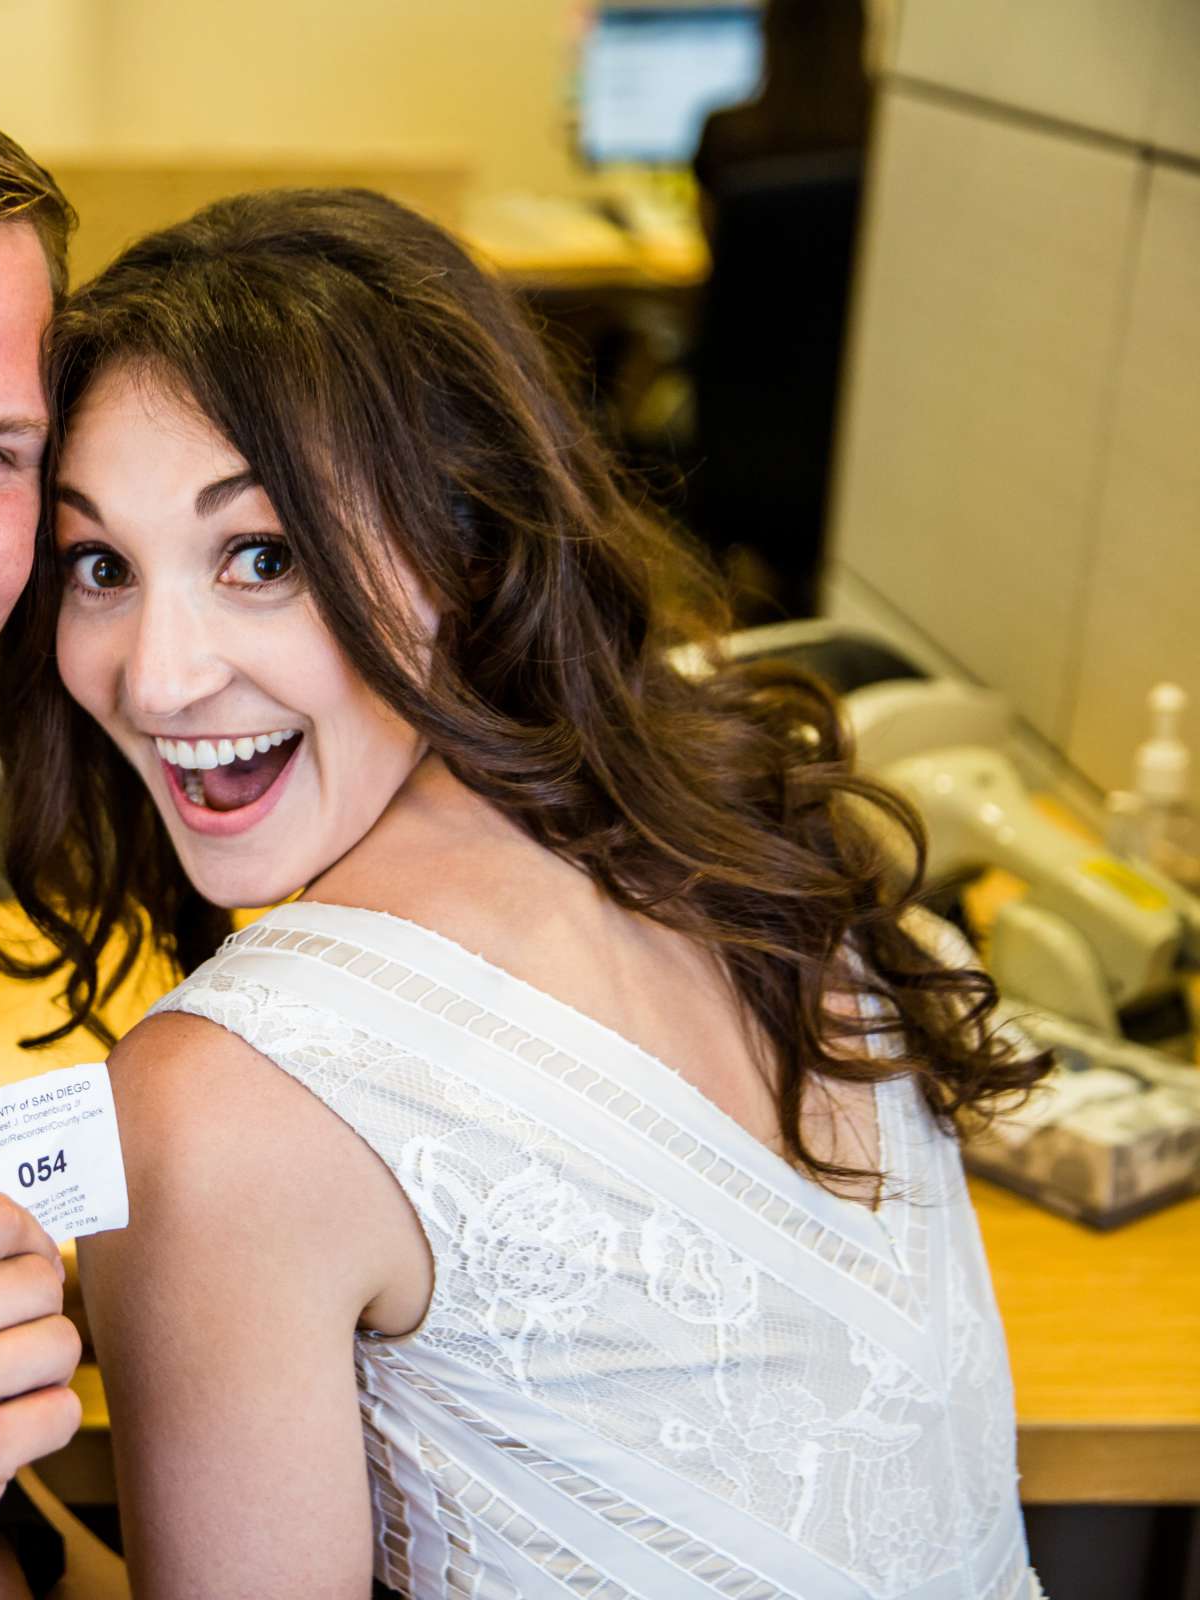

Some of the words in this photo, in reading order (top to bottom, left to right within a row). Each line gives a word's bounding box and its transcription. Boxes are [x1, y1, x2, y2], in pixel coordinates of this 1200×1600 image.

[19, 1099, 28, 1110] of
[32, 1092, 54, 1106] SAN
[56, 1080, 92, 1099] DIEGO
[81, 1107, 103, 1120] Clerk
[18, 1149, 68, 1188] 054
[59, 1204, 84, 1219] CALLED
